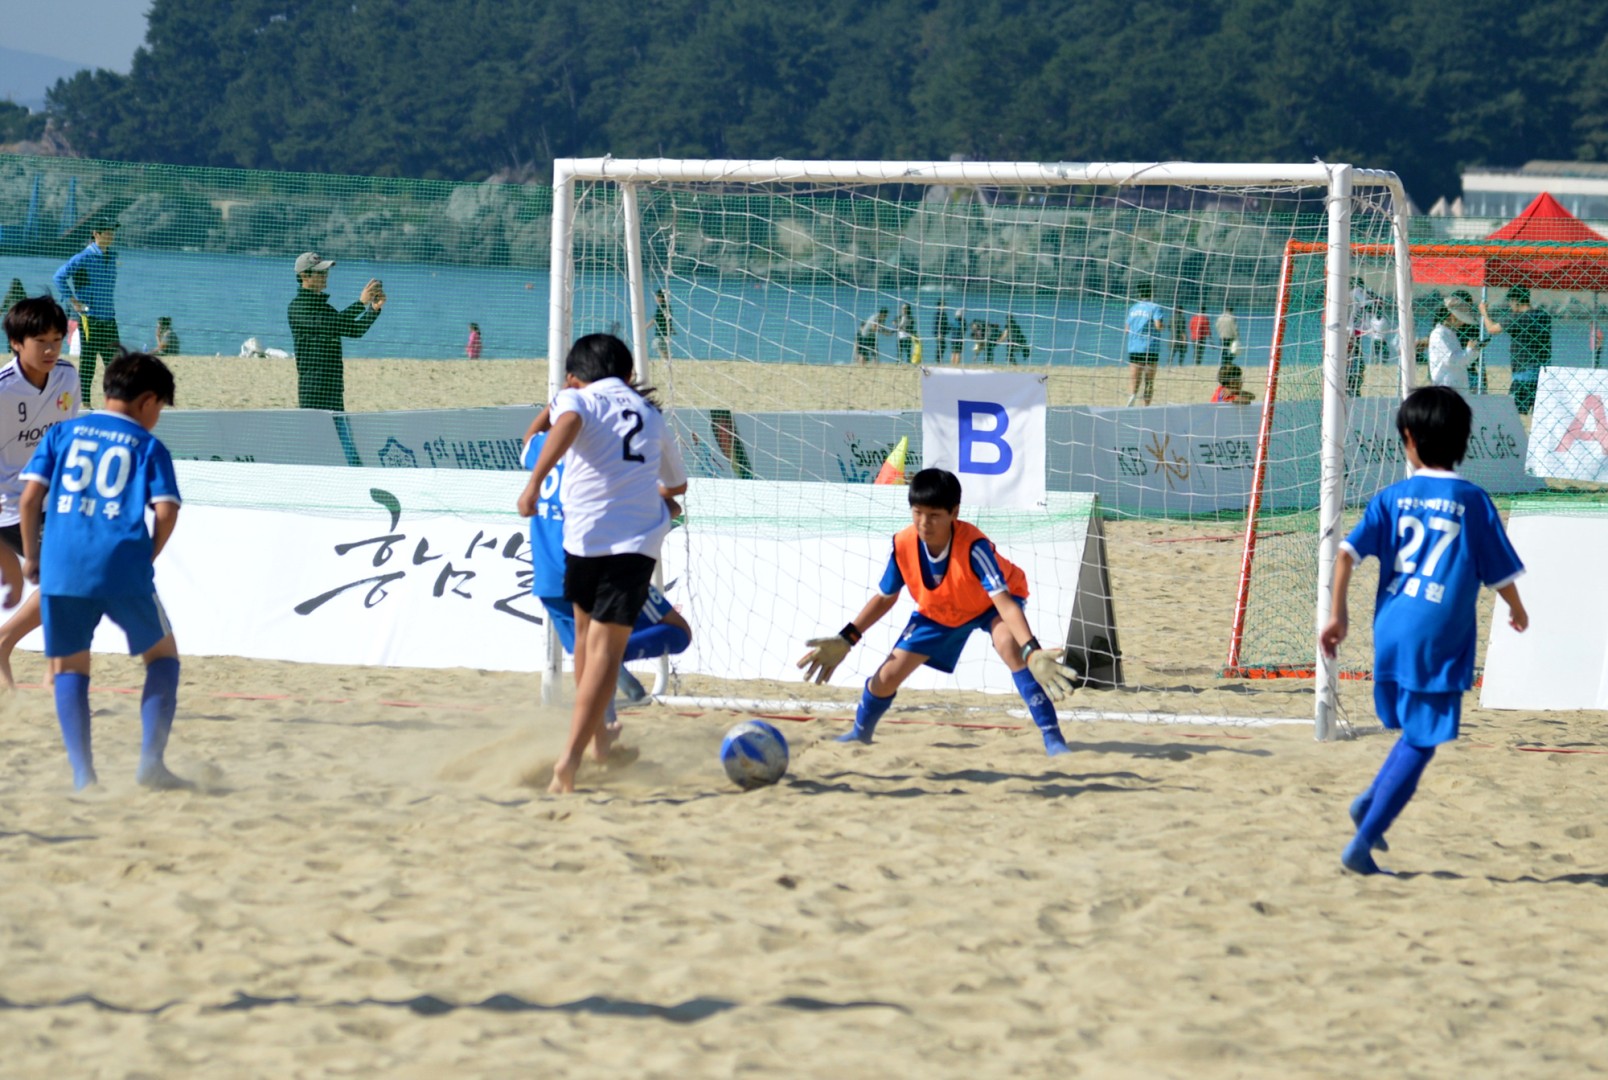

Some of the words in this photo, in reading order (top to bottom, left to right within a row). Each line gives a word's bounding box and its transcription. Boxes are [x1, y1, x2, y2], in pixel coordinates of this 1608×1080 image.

[17, 420, 61, 441] HOO
[18, 401, 27, 422] 9
[622, 408, 645, 464] 2
[957, 399, 1013, 475] B
[1554, 394, 1608, 456] A
[61, 437, 131, 499] 50
[1393, 515, 1461, 577] 27
